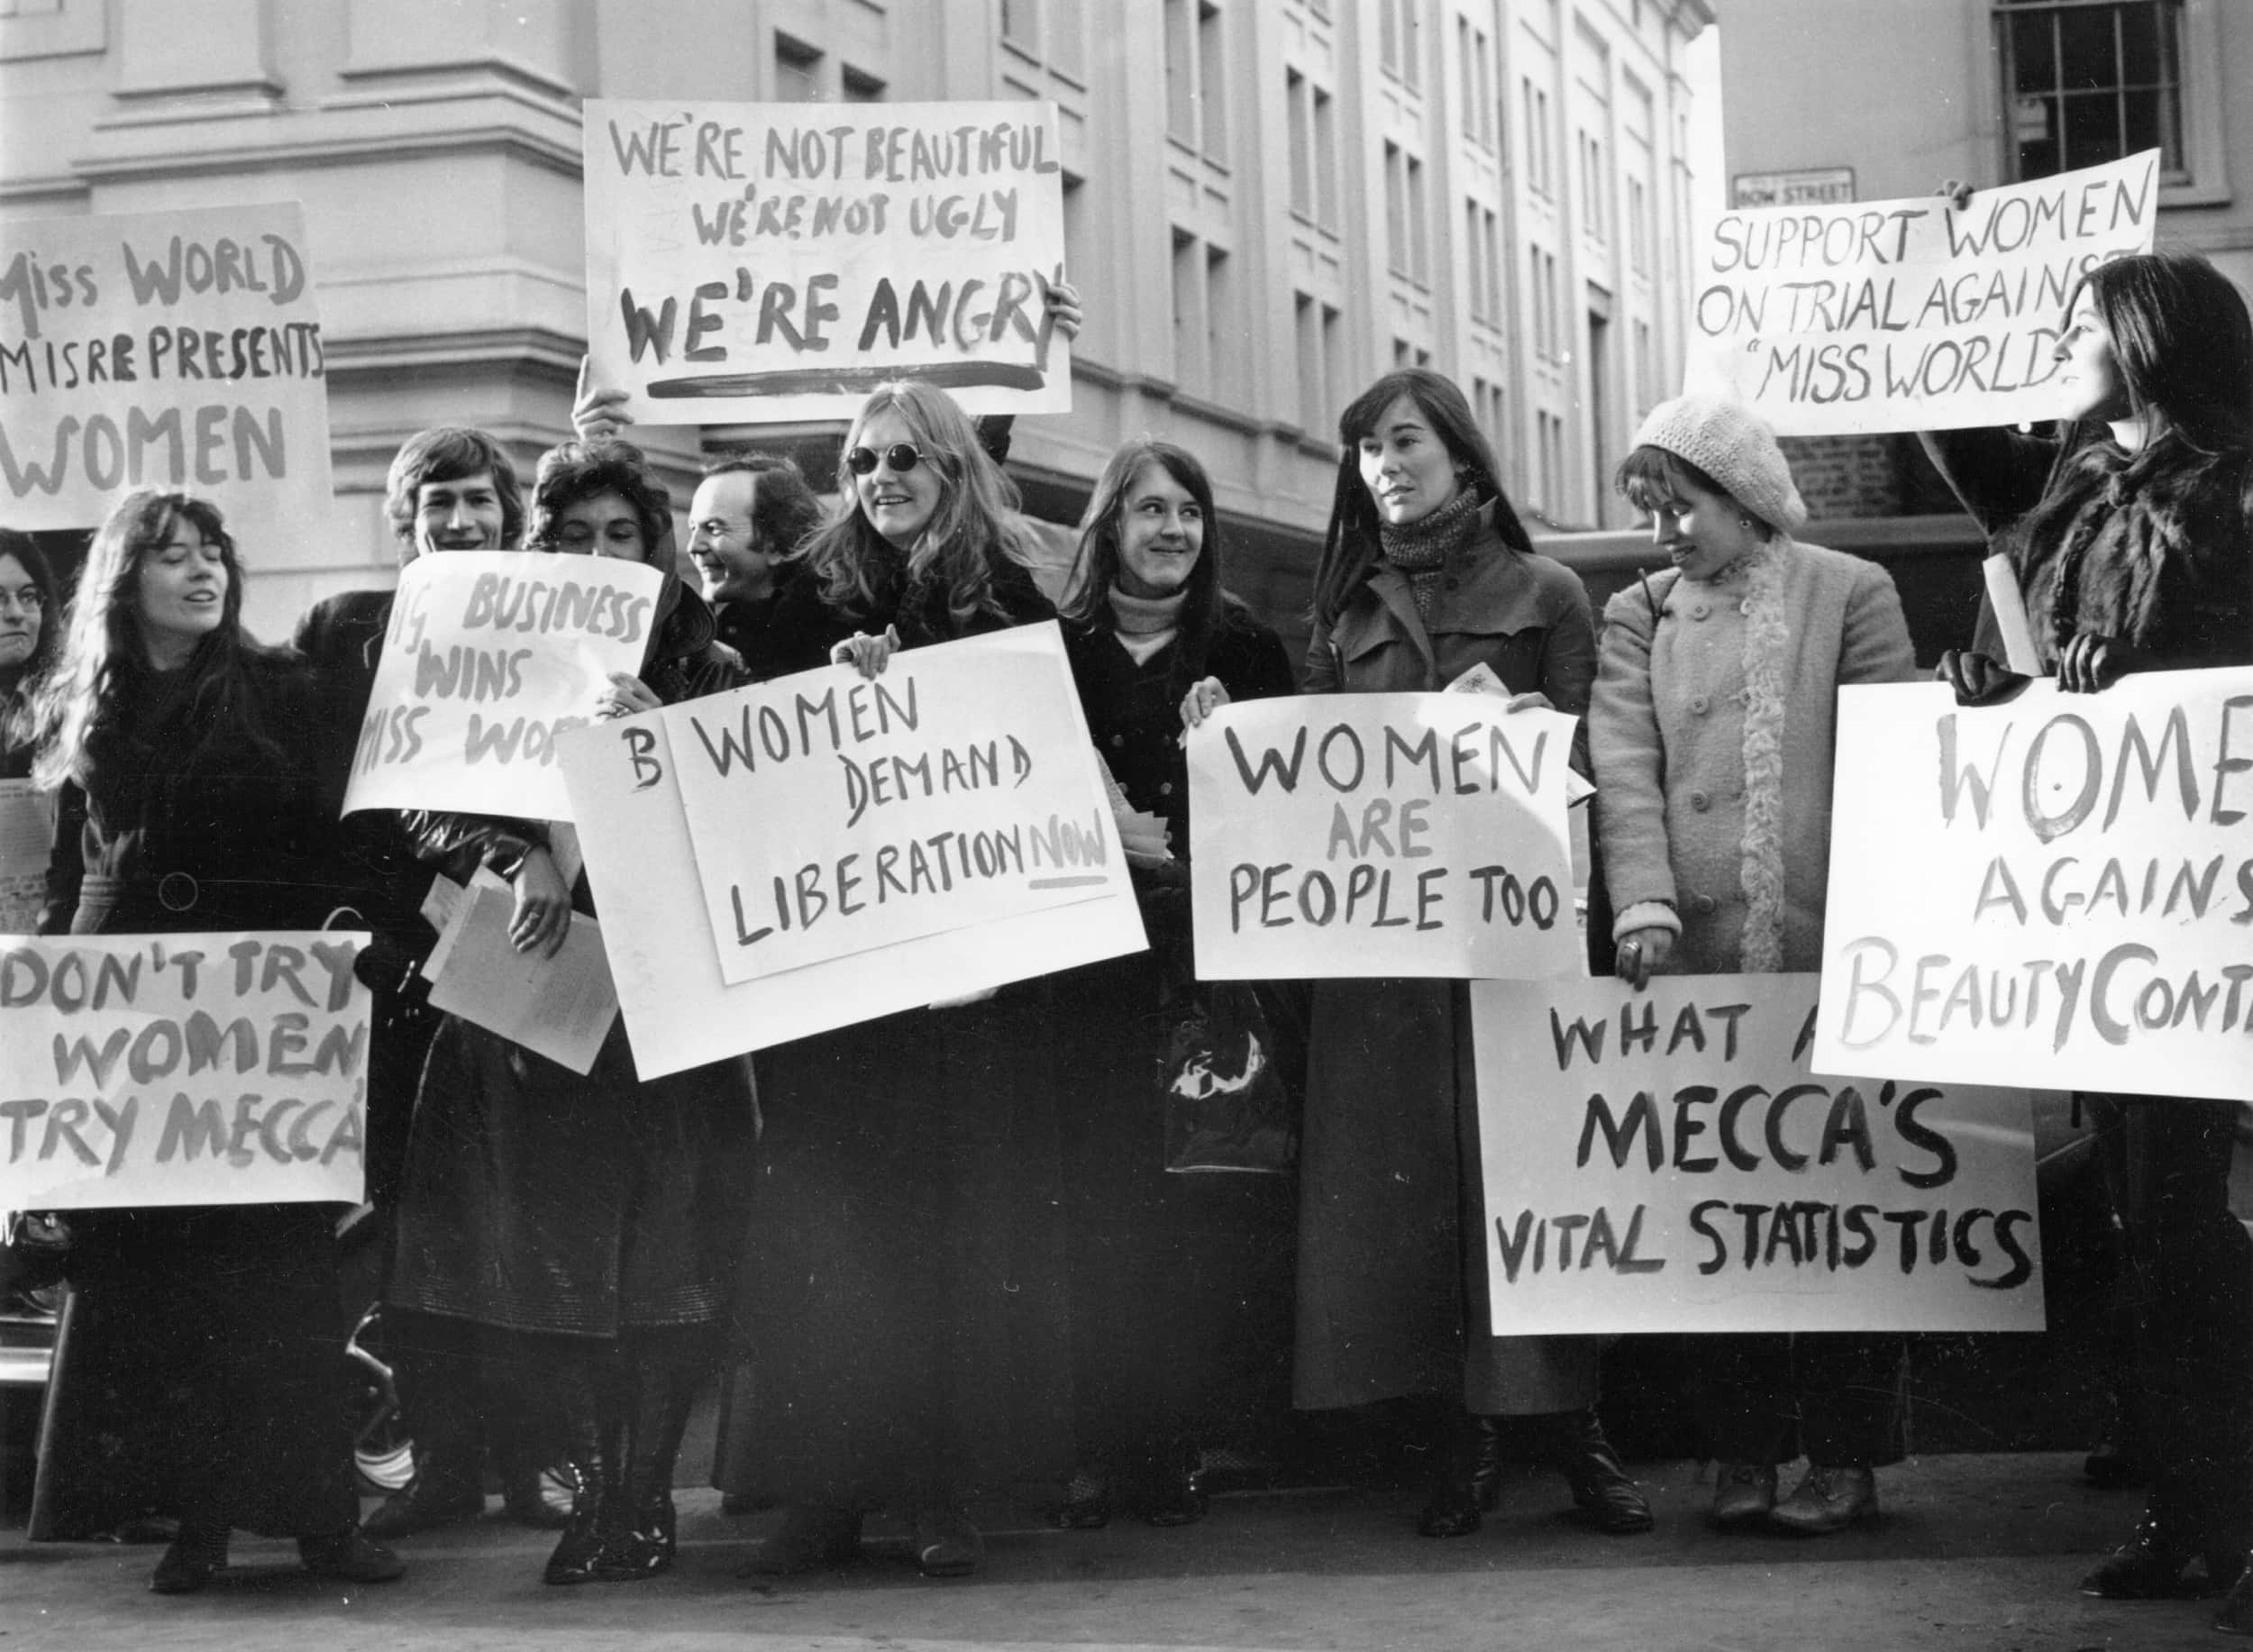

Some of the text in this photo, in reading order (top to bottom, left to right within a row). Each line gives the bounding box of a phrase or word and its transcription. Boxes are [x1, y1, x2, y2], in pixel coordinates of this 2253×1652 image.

[609, 112, 1059, 182] WE'RE NOT BEAUTIFUL
[691, 183, 1017, 246] WE'RE NOT UGLY
[1712, 160, 2154, 273] SUPPORT WOMEN
[1784, 183, 1851, 205] STREET
[123, 233, 306, 306] WORLD
[1697, 243, 2145, 336] ON TRIAL AGAIN
[620, 262, 1063, 371] WE'RE ANGRY
[0, 405, 286, 497] WOMEN
[462, 571, 650, 643] BUSINESS
[415, 638, 532, 703] WINS
[464, 713, 589, 767] WOR
[621, 726, 662, 788] B
[691, 676, 918, 778] WOMEN
[1225, 722, 1549, 796] WOMEN
[837, 735, 1032, 828] DEMAND
[1936, 694, 2253, 844] WOME
[1327, 798, 1433, 861] ARE
[731, 807, 1108, 946] LIBERATION NOW
[1230, 863, 1559, 934] PEOPLE TOO
[0, 939, 356, 1015] DON'T TRY
[2090, 942, 2253, 1046] CONT
[52, 1009, 369, 1091] WOMEN
[1550, 1000, 1752, 1071] WHAT
[0, 1077, 365, 1177] TRY MECCA
[1576, 1079, 1958, 1190] MECCA'S
[1495, 1200, 2033, 1290] VITAL STATISTICS
